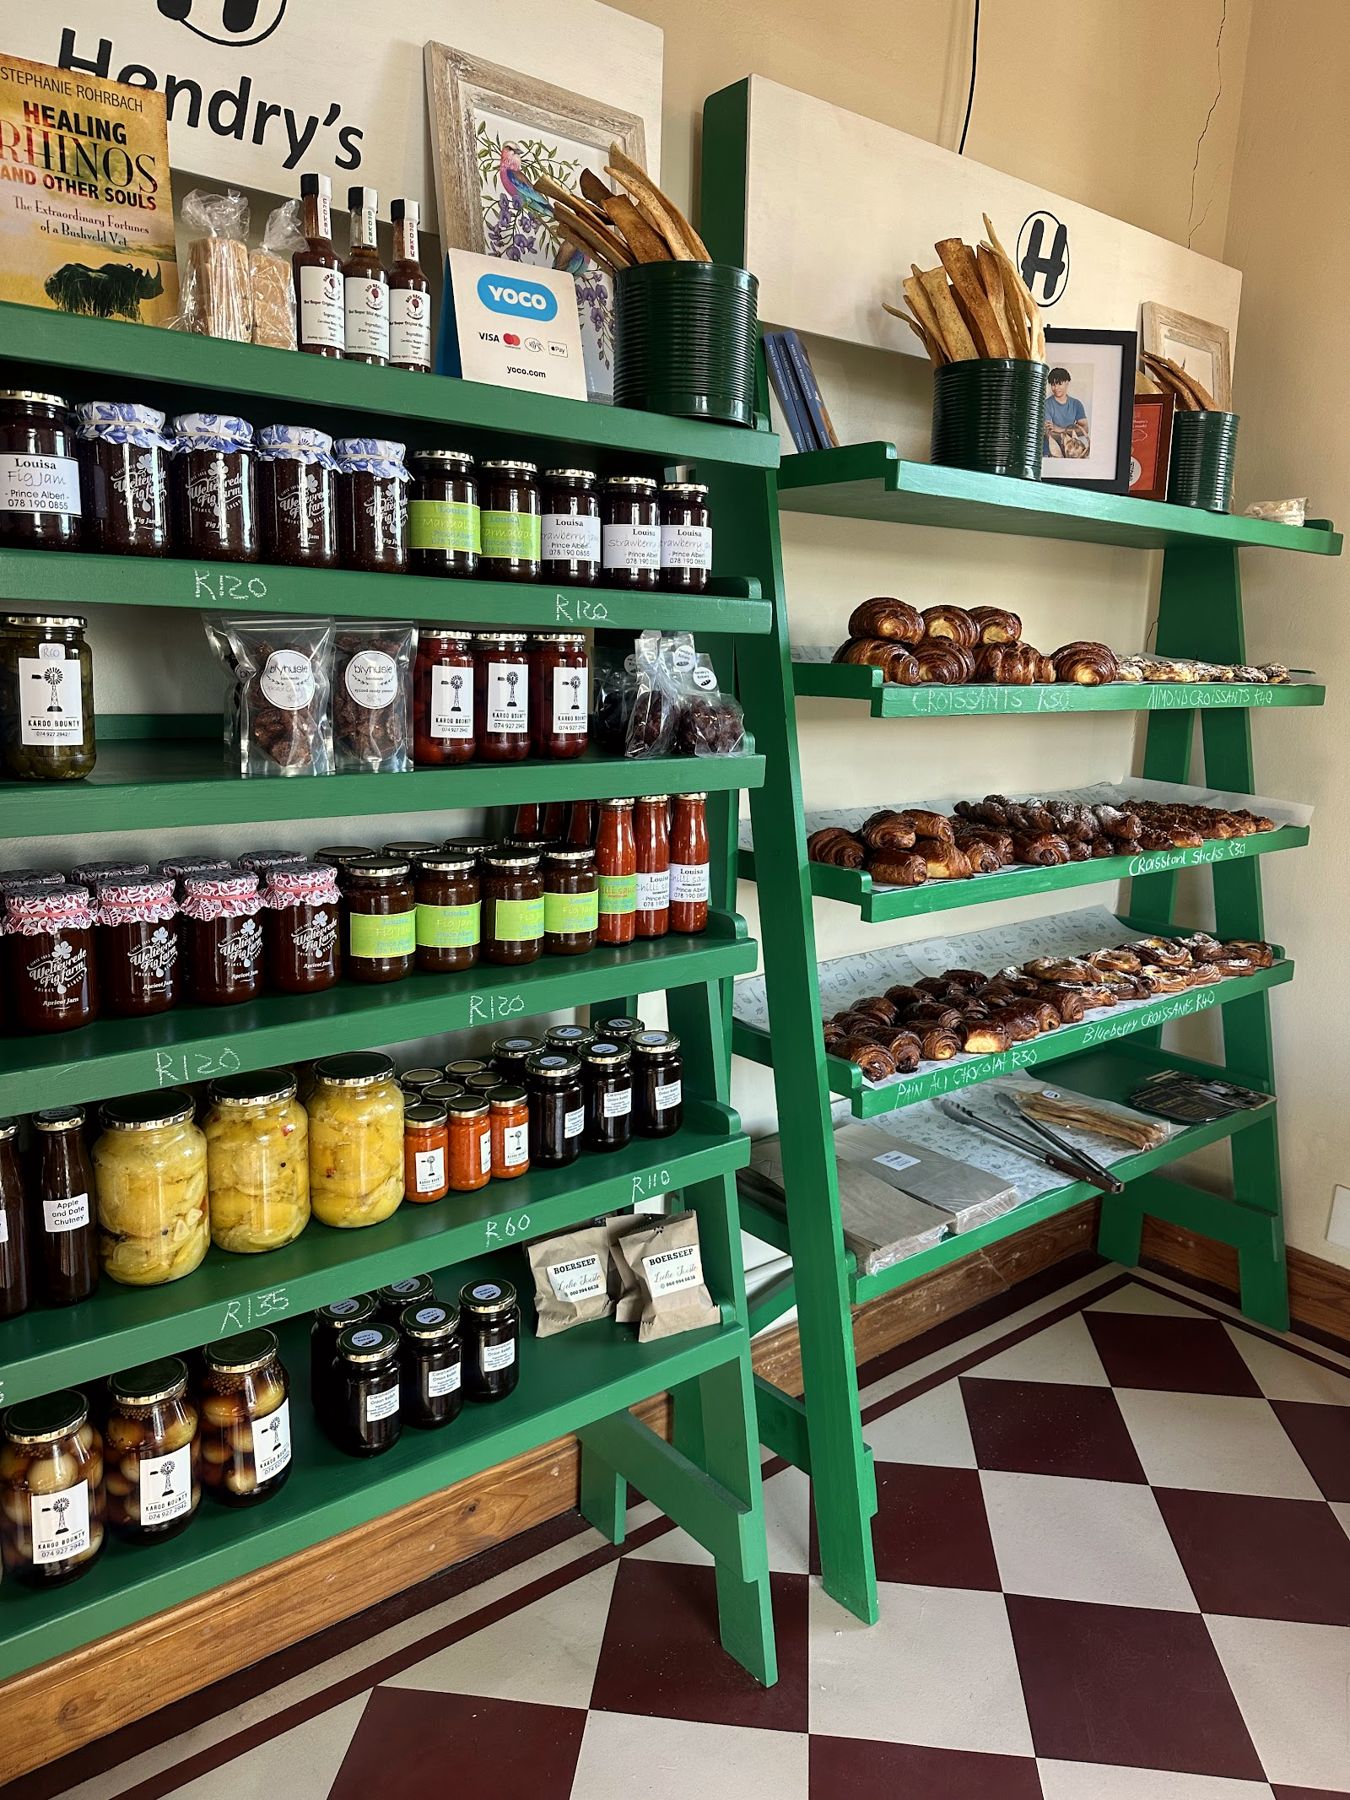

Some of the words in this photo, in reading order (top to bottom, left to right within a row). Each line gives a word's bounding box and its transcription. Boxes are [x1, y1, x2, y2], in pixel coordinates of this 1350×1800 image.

[1, 66, 72, 96] STEPHANIE
[77, 84, 143, 113] ROHRBACH
[23, 100, 127, 145] HEALING
[0, 119, 158, 194] RHINOS
[0, 166, 36, 185] AND
[43, 174, 99, 200] OTHER
[105, 187, 157, 211] SOULS
[14, 196, 33, 211] The
[36, 200, 105, 228] Extraordinary
[108, 214, 150, 234] Fortunes
[41, 219, 50, 234] of
[53, 226, 59, 234] a
[62, 222, 107, 243] Bushveld
[110, 231, 128, 247] Vet
[488, 285, 547, 310] YOCO
[479, 332, 500, 343] VISA
[507, 366, 546, 378] yoco.com
[15, 458, 56, 470] Louisa
[10, 489, 39, 499] Prince
[8, 499, 25, 507] 078
[29, 500, 46, 509] 190
[48, 500, 68, 510] 0855
[556, 519, 584, 527] Louisa
[677, 529, 702, 537] Louisa
[194, 568, 267, 600] R120
[28, 948, 87, 980] Weltevrede
[141, 958, 158, 972] Fig
[40, 971, 59, 988] Fig
[470, 994, 524, 1027] R120
[1083, 1020, 1138, 1043] Blueberry
[155, 1047, 240, 1086] R120
[632, 1170, 670, 1203] R110
[52, 1210, 67, 1218] and
[69, 1205, 85, 1216] Date
[57, 1199, 79, 1209] Apple
[54, 1215, 84, 1226] Chutney
[649, 1248, 694, 1266] BOERSEEP
[553, 1258, 596, 1275] BOERSEEP
[220, 1288, 289, 1334] R135
[167, 1493, 188, 1506] BOUNTY
[149, 1512, 161, 1521] 074
[161, 1509, 174, 1518] 927
[61, 1531, 85, 1545] BOUNTY
[41, 1550, 54, 1558] 074
[55, 1546, 68, 1555] 927
[69, 1540, 85, 1551] 2942
